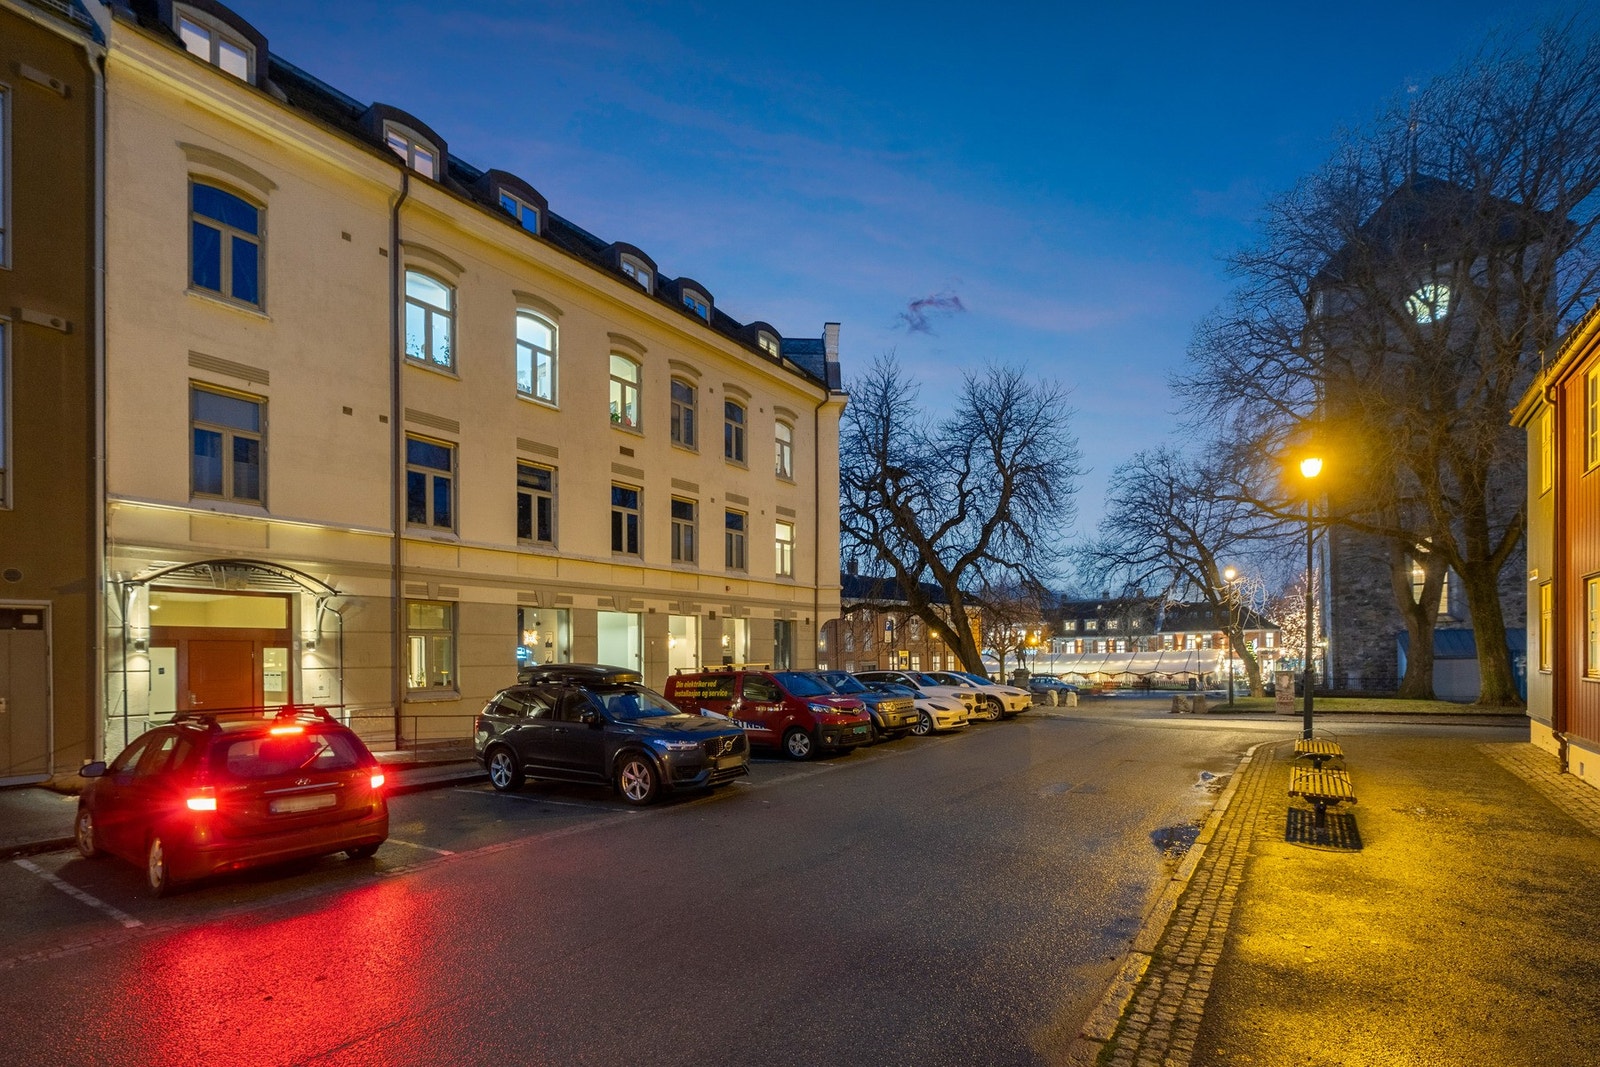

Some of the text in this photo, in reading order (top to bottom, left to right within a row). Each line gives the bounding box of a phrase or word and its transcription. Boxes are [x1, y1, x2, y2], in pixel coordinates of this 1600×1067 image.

[684, 680, 707, 688] elektriker
[707, 679, 717, 688] ved
[702, 691, 708, 699] og
[709, 689, 727, 697] service
